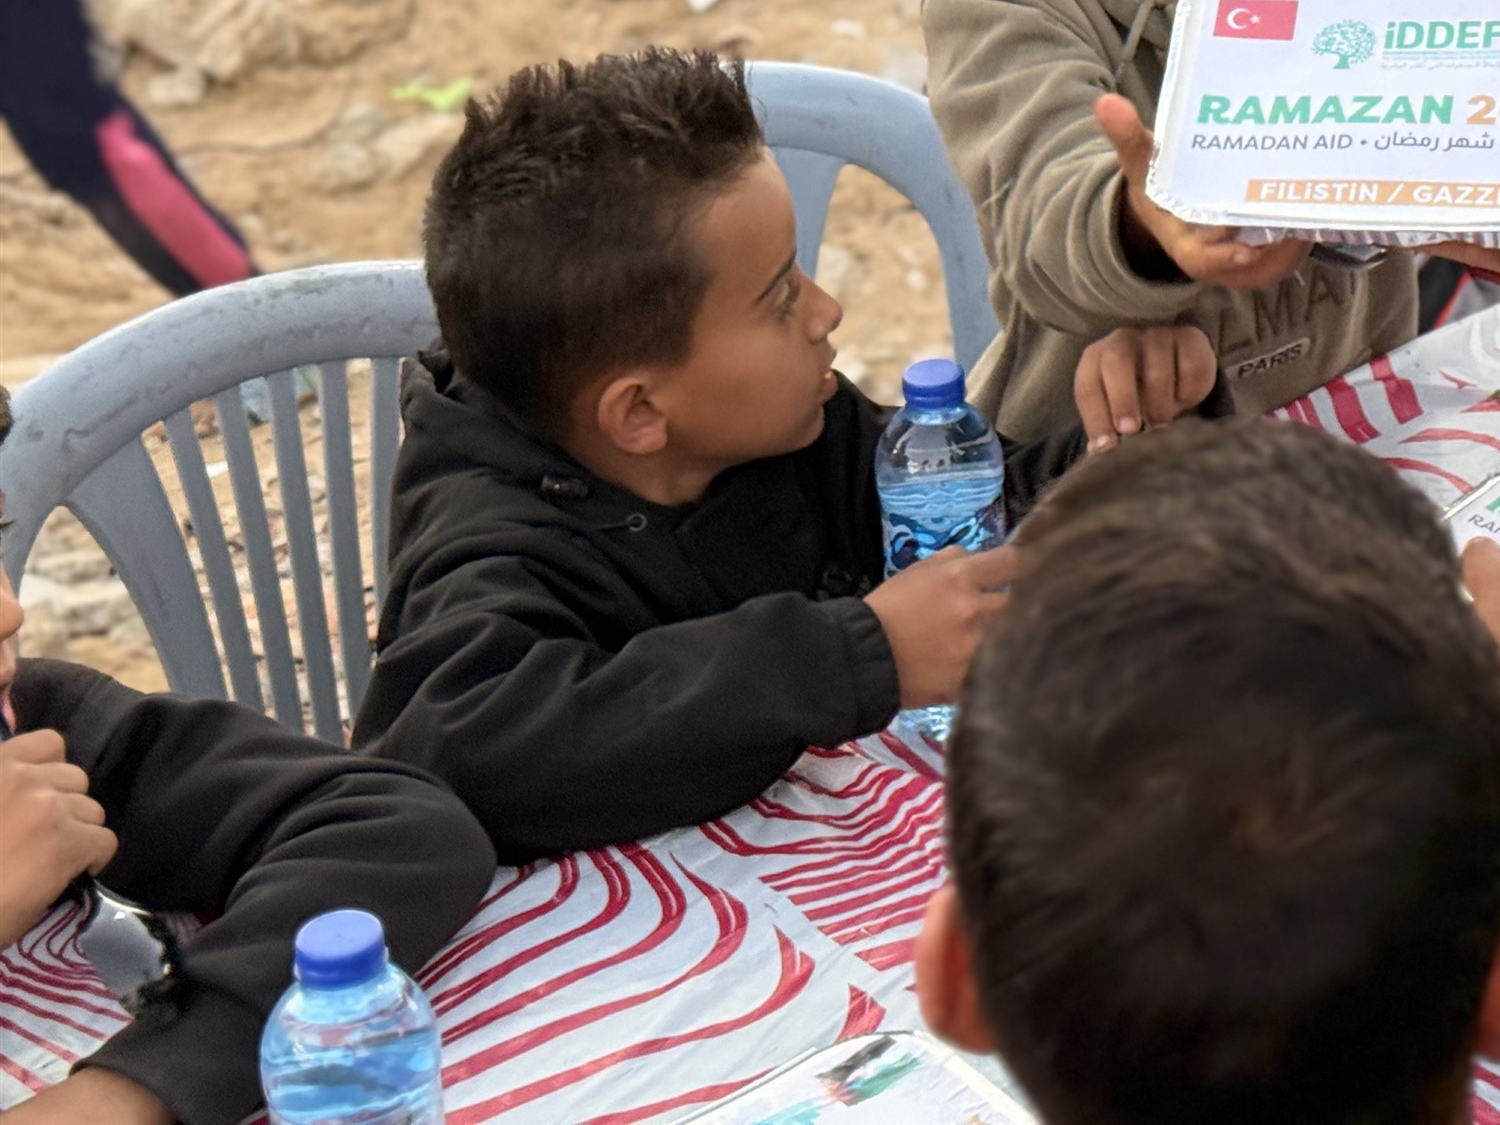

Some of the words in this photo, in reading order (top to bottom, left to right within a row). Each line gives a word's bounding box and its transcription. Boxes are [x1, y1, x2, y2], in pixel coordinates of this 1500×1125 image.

[1197, 94, 1454, 125] RAMAZAN
[1191, 134, 1308, 150] RAMADAN
[1313, 134, 1353, 150] AID
[1374, 131, 1440, 152] رمضان
[1442, 132, 1494, 152] شهر
[1237, 343, 1302, 378] PARIS
